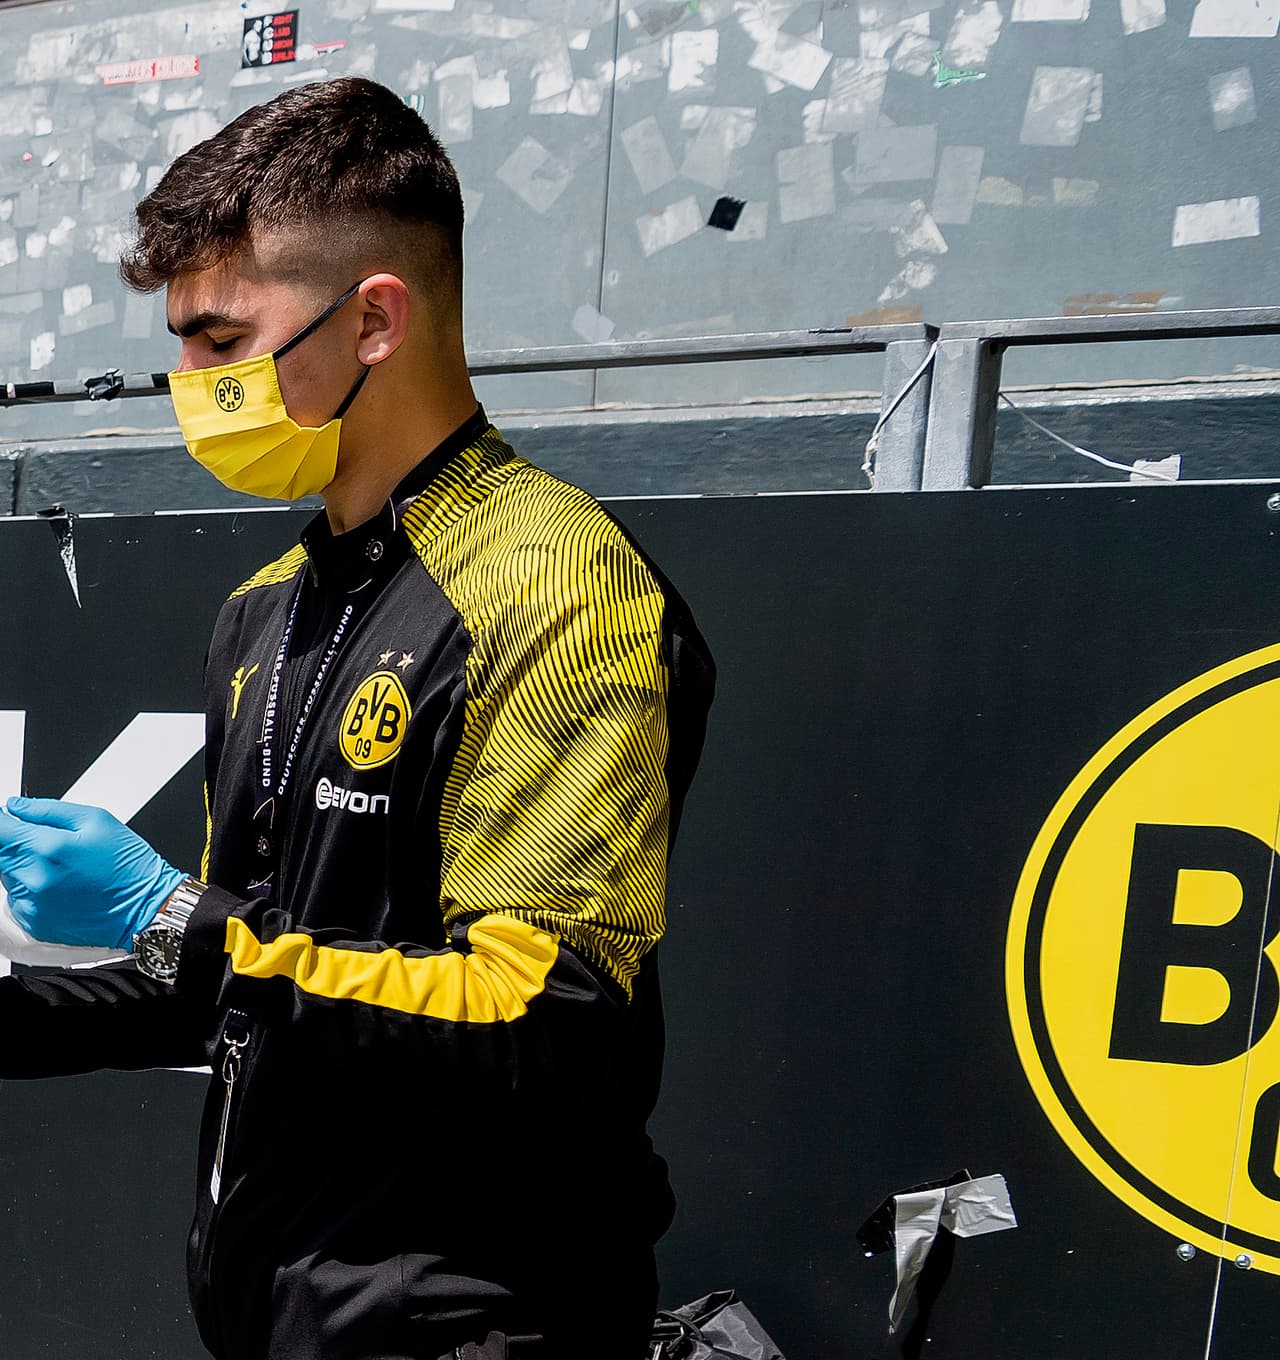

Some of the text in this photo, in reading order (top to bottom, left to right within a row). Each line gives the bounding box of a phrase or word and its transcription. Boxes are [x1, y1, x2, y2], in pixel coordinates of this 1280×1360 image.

[218, 376, 243, 402] BVB
[277, 604, 354, 795] DEUTSCHER FUSSBALL-BUND
[347, 680, 401, 743] BVB
[354, 736, 372, 760] 09
